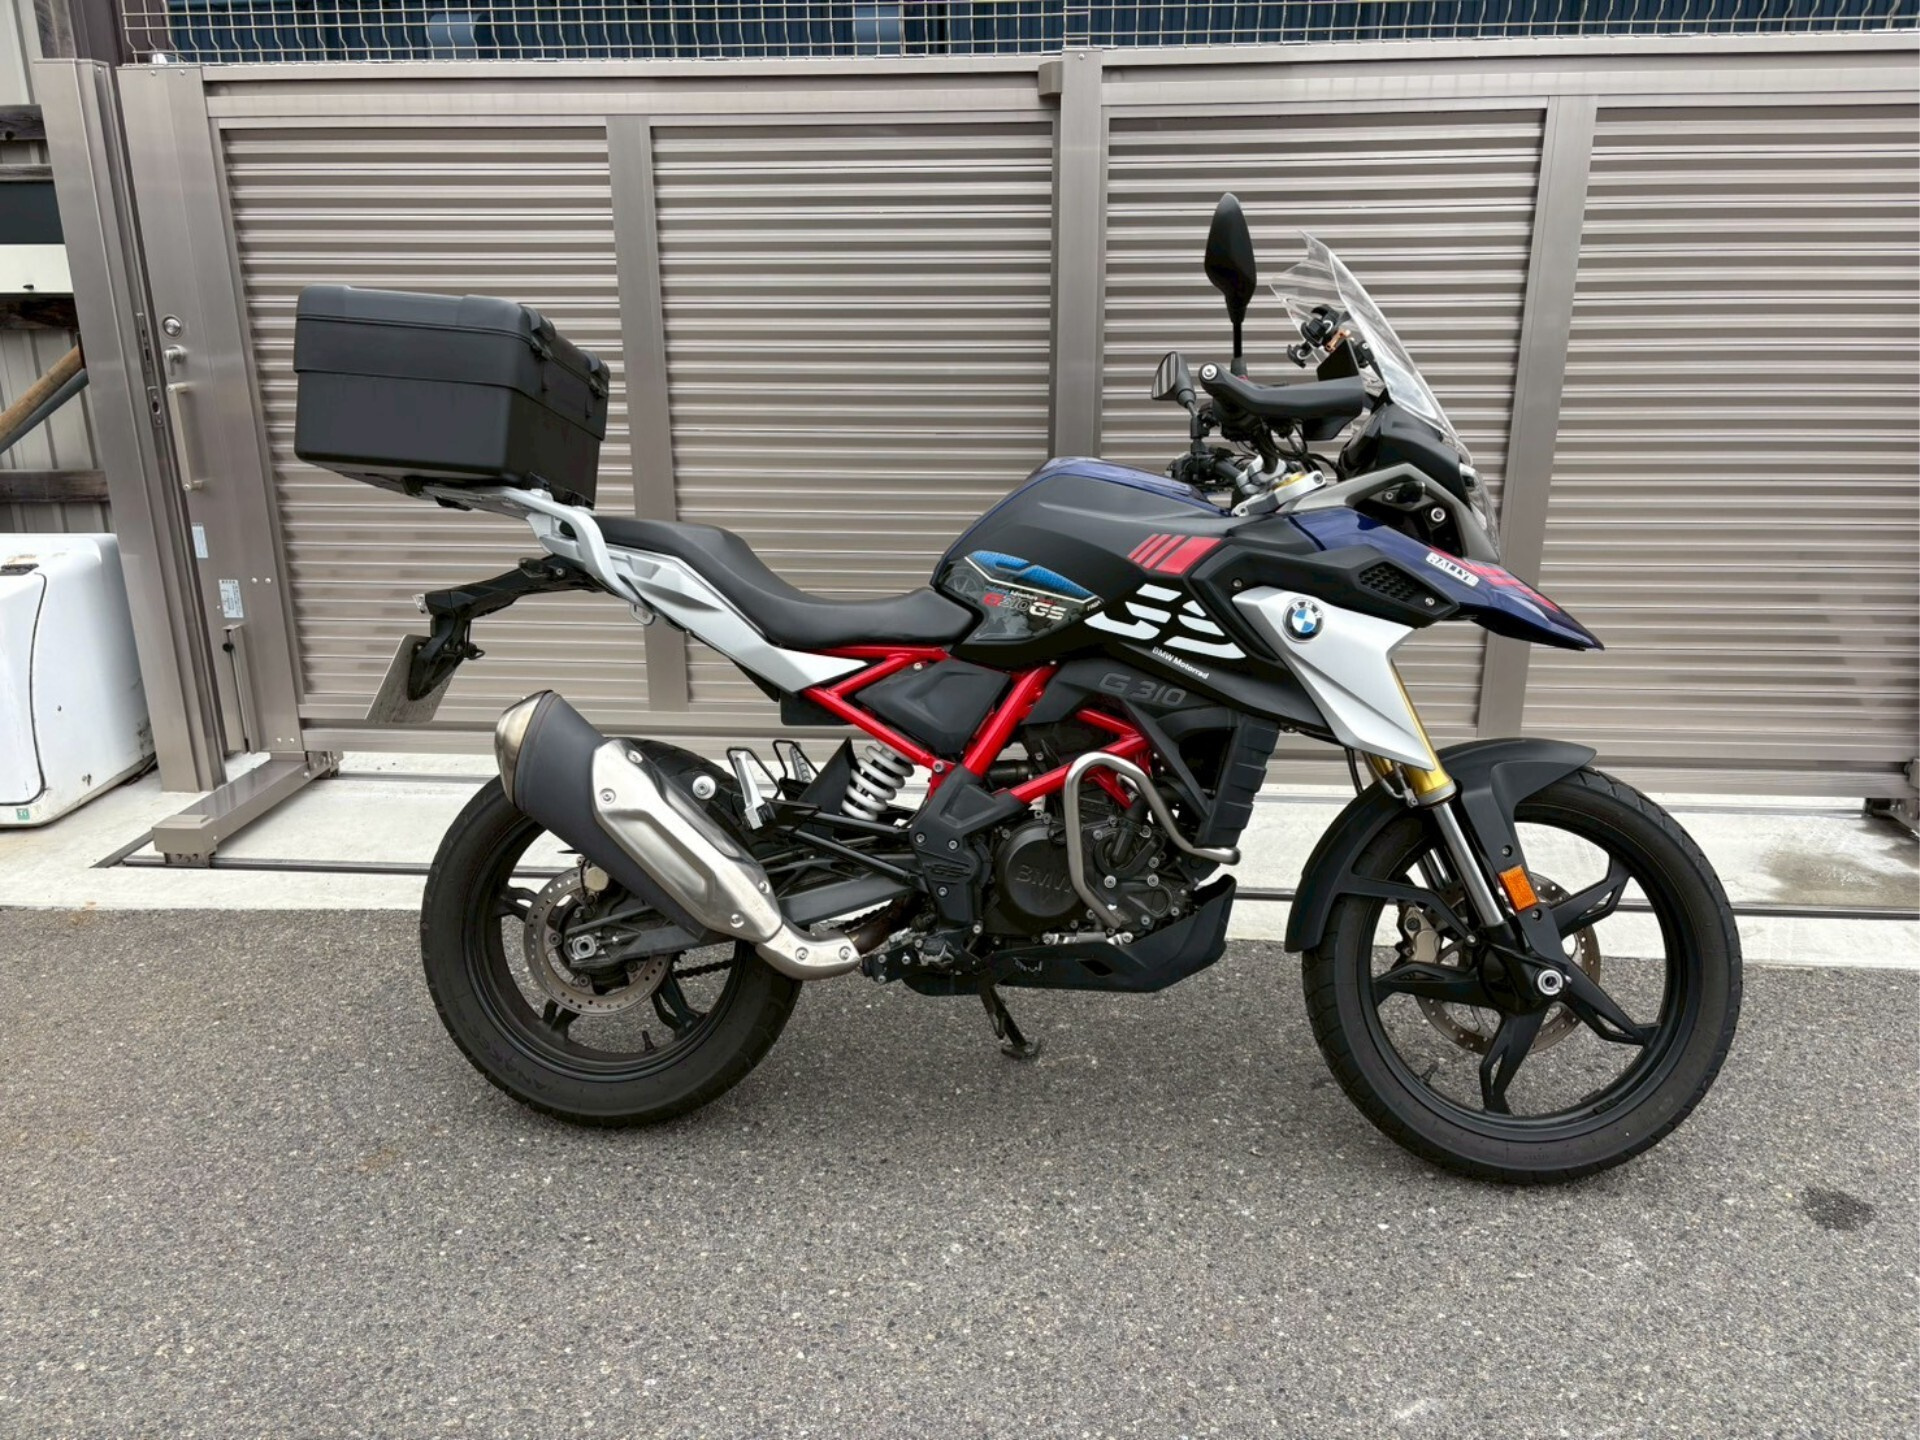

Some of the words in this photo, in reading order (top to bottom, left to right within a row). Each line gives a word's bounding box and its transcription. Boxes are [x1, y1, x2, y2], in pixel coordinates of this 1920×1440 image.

[1152, 646, 1174, 663] BMW
[1173, 656, 1210, 680] Motorrad
[1099, 672, 1131, 692] G
[1130, 680, 1187, 706] 310
